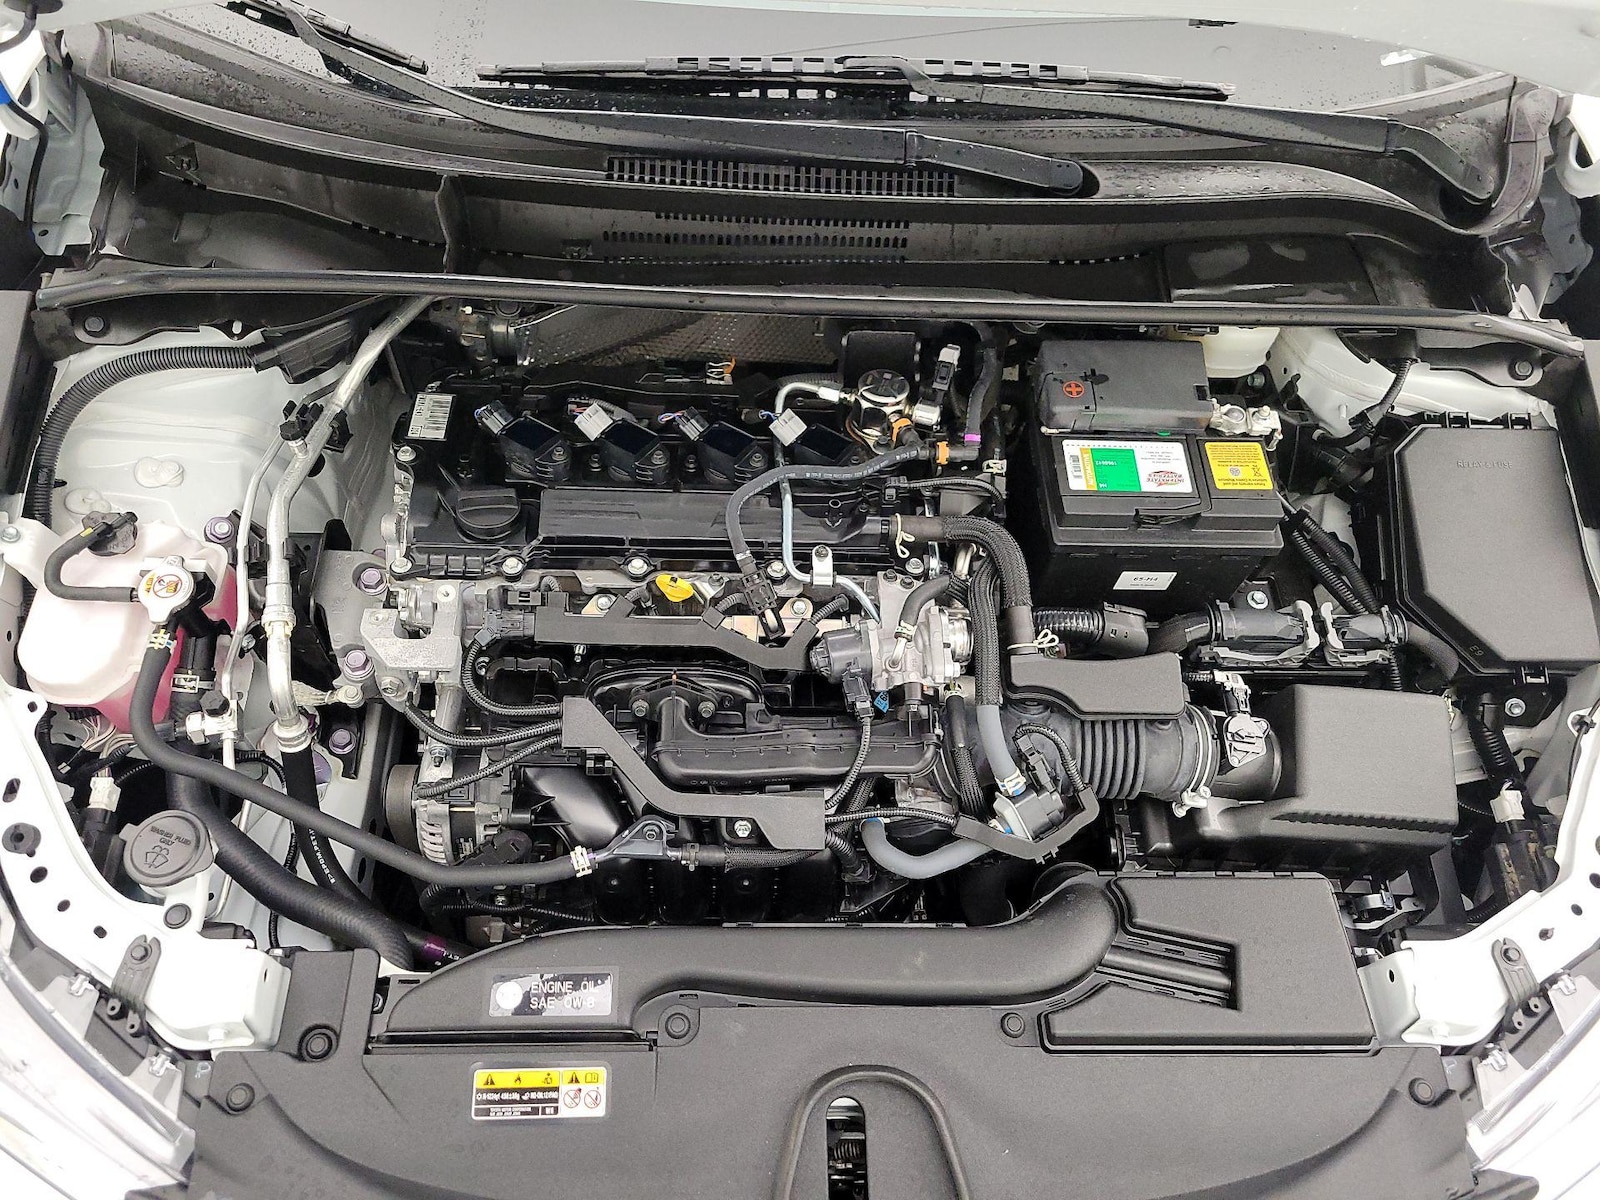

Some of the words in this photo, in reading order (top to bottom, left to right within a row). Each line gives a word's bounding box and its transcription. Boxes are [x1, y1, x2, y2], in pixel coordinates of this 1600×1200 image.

[1456, 460, 1482, 469] RELAY
[1492, 461, 1513, 470] FUSE
[1469, 645, 1484, 656] E9
[150, 825, 174, 839] WASHER
[530, 981, 574, 994] ENGINE
[580, 980, 599, 993] OIL
[529, 997, 556, 1009] SAE
